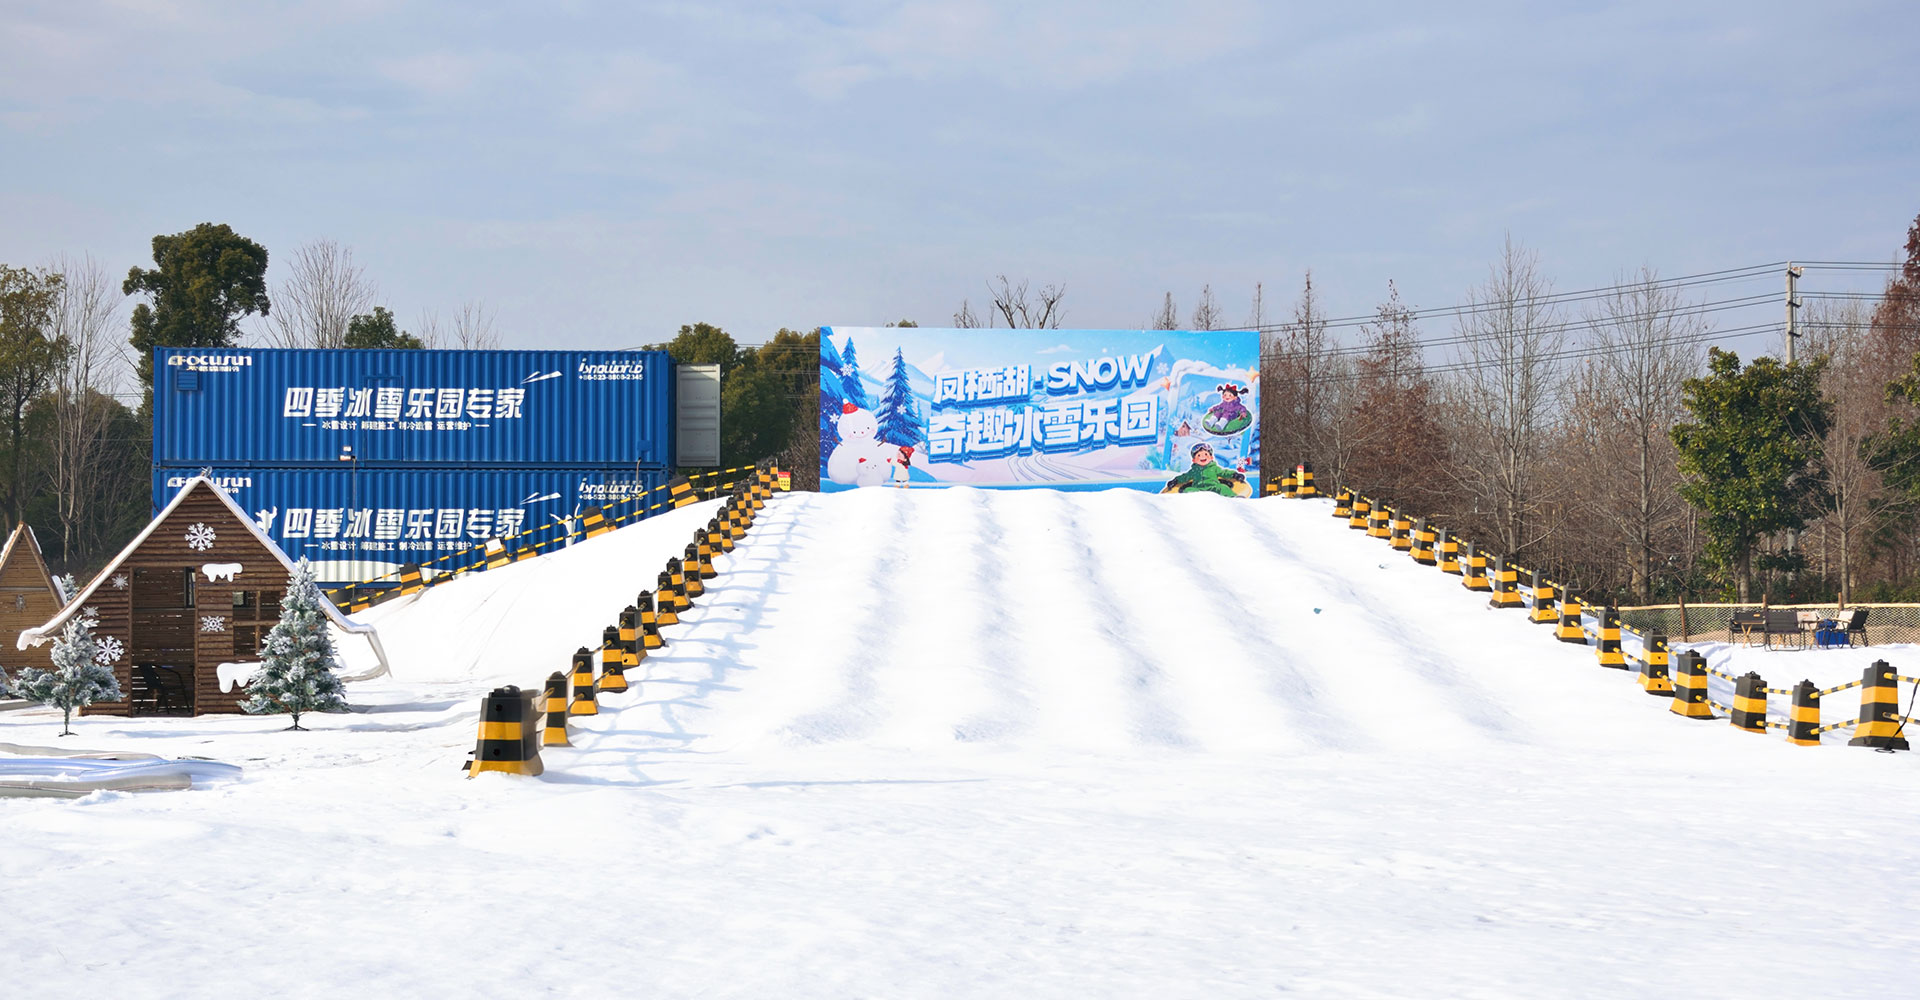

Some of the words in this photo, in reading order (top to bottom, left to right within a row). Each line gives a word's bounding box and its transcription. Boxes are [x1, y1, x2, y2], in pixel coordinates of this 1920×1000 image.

[283, 387, 526, 418] 四季冰雪乐园专家
[322, 421, 357, 430] 冰雪设计
[927, 395, 1159, 462] 奇趣冰雪乐园
[282, 508, 526, 539] 四季冰雪乐园专家
